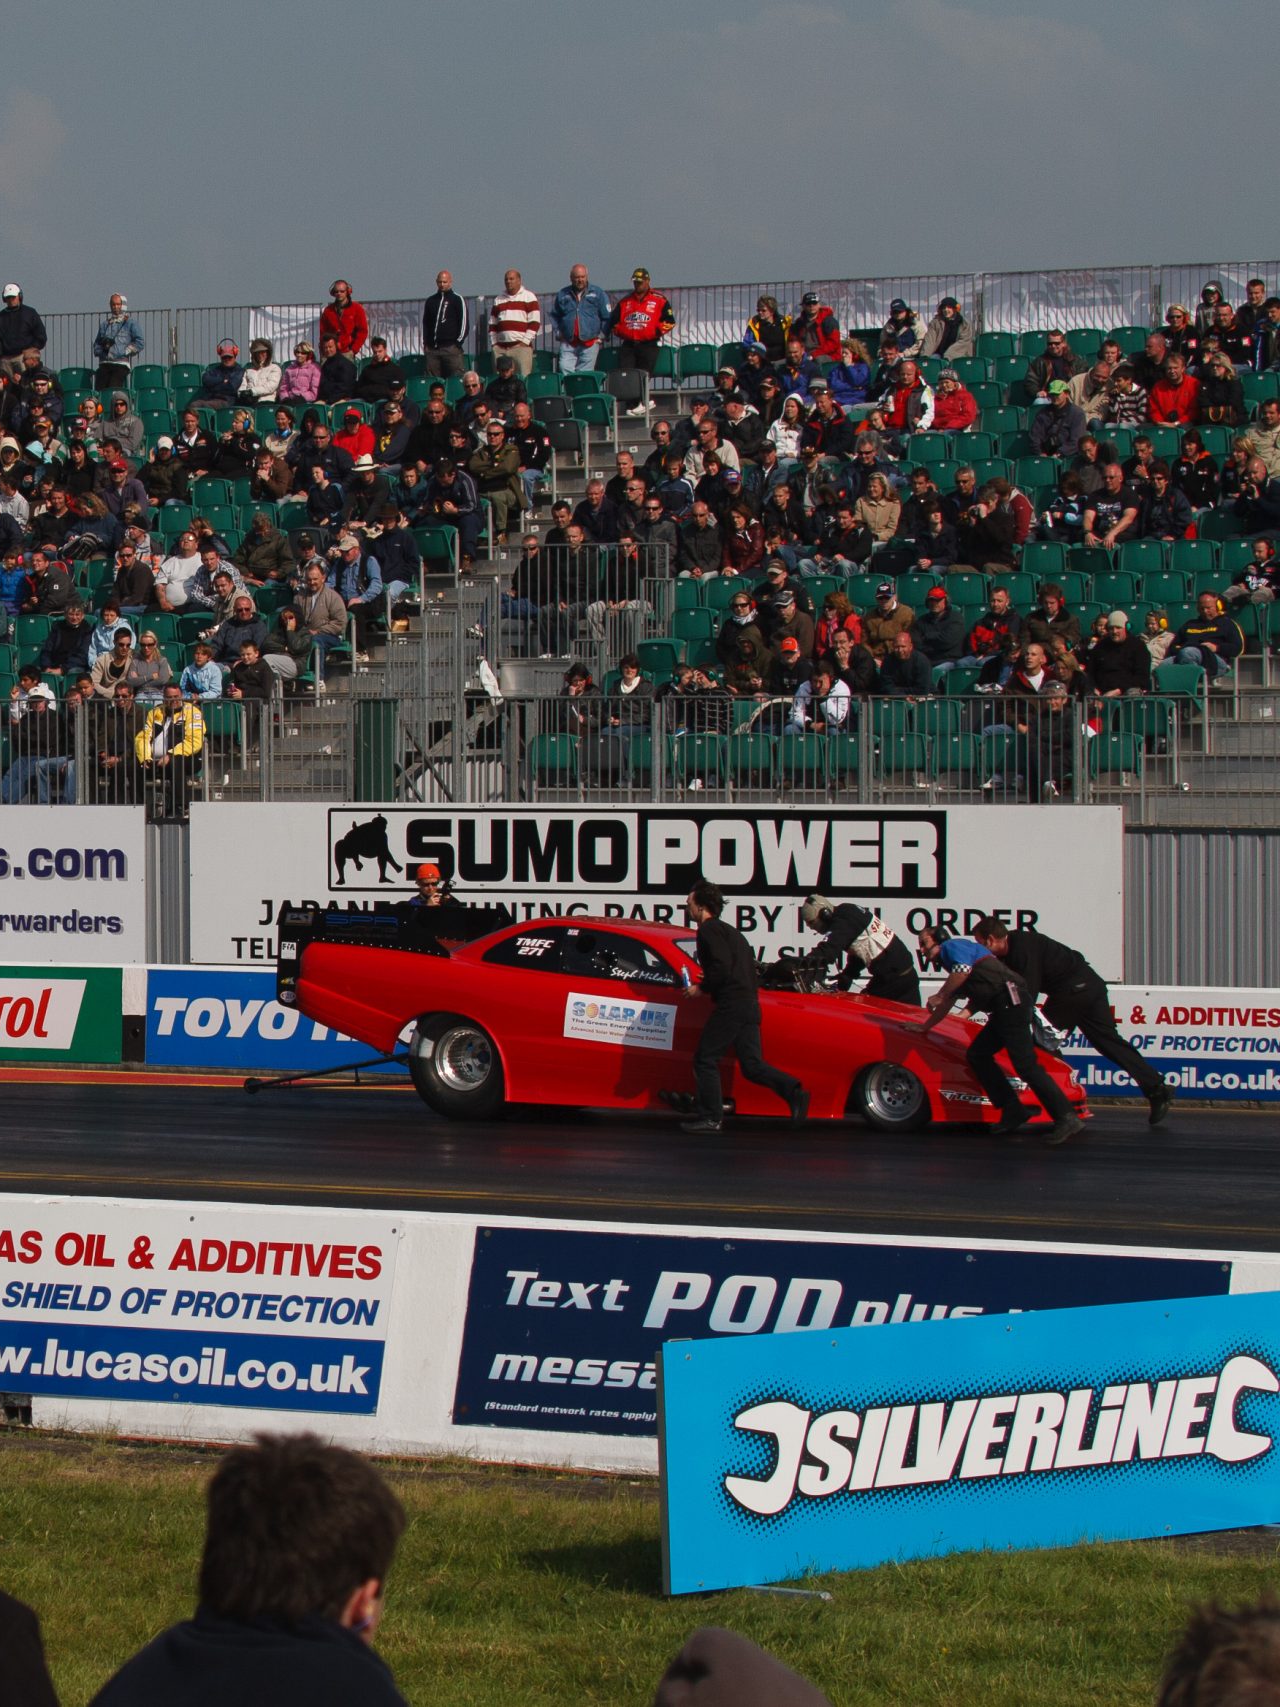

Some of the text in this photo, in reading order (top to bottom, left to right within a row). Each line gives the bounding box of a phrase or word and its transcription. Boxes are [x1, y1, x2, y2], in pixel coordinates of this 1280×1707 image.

[406, 819, 938, 887] SUMO POWER
[736, 905, 783, 932] BY
[516, 937, 555, 949] TMFC
[154, 997, 300, 1040] TOYO
[572, 1001, 670, 1028] SOLAR UK
[609, 1022, 636, 1031] Energy
[1130, 1005, 1147, 1025] &
[1155, 1006, 1280, 1028] ADDITIVES
[1129, 1034, 1157, 1050] OF
[54, 1231, 116, 1269] OIL
[127, 1236, 154, 1271] &
[168, 1238, 382, 1281] ADDITIVES
[1, 1281, 112, 1313] SHIELD
[120, 1287, 166, 1318] OF
[172, 1291, 380, 1327] PROTECTION
[506, 1271, 630, 1312] Text
[643, 1272, 843, 1333] POD
[484, 1401, 657, 1422] (Standard network rates apply)
